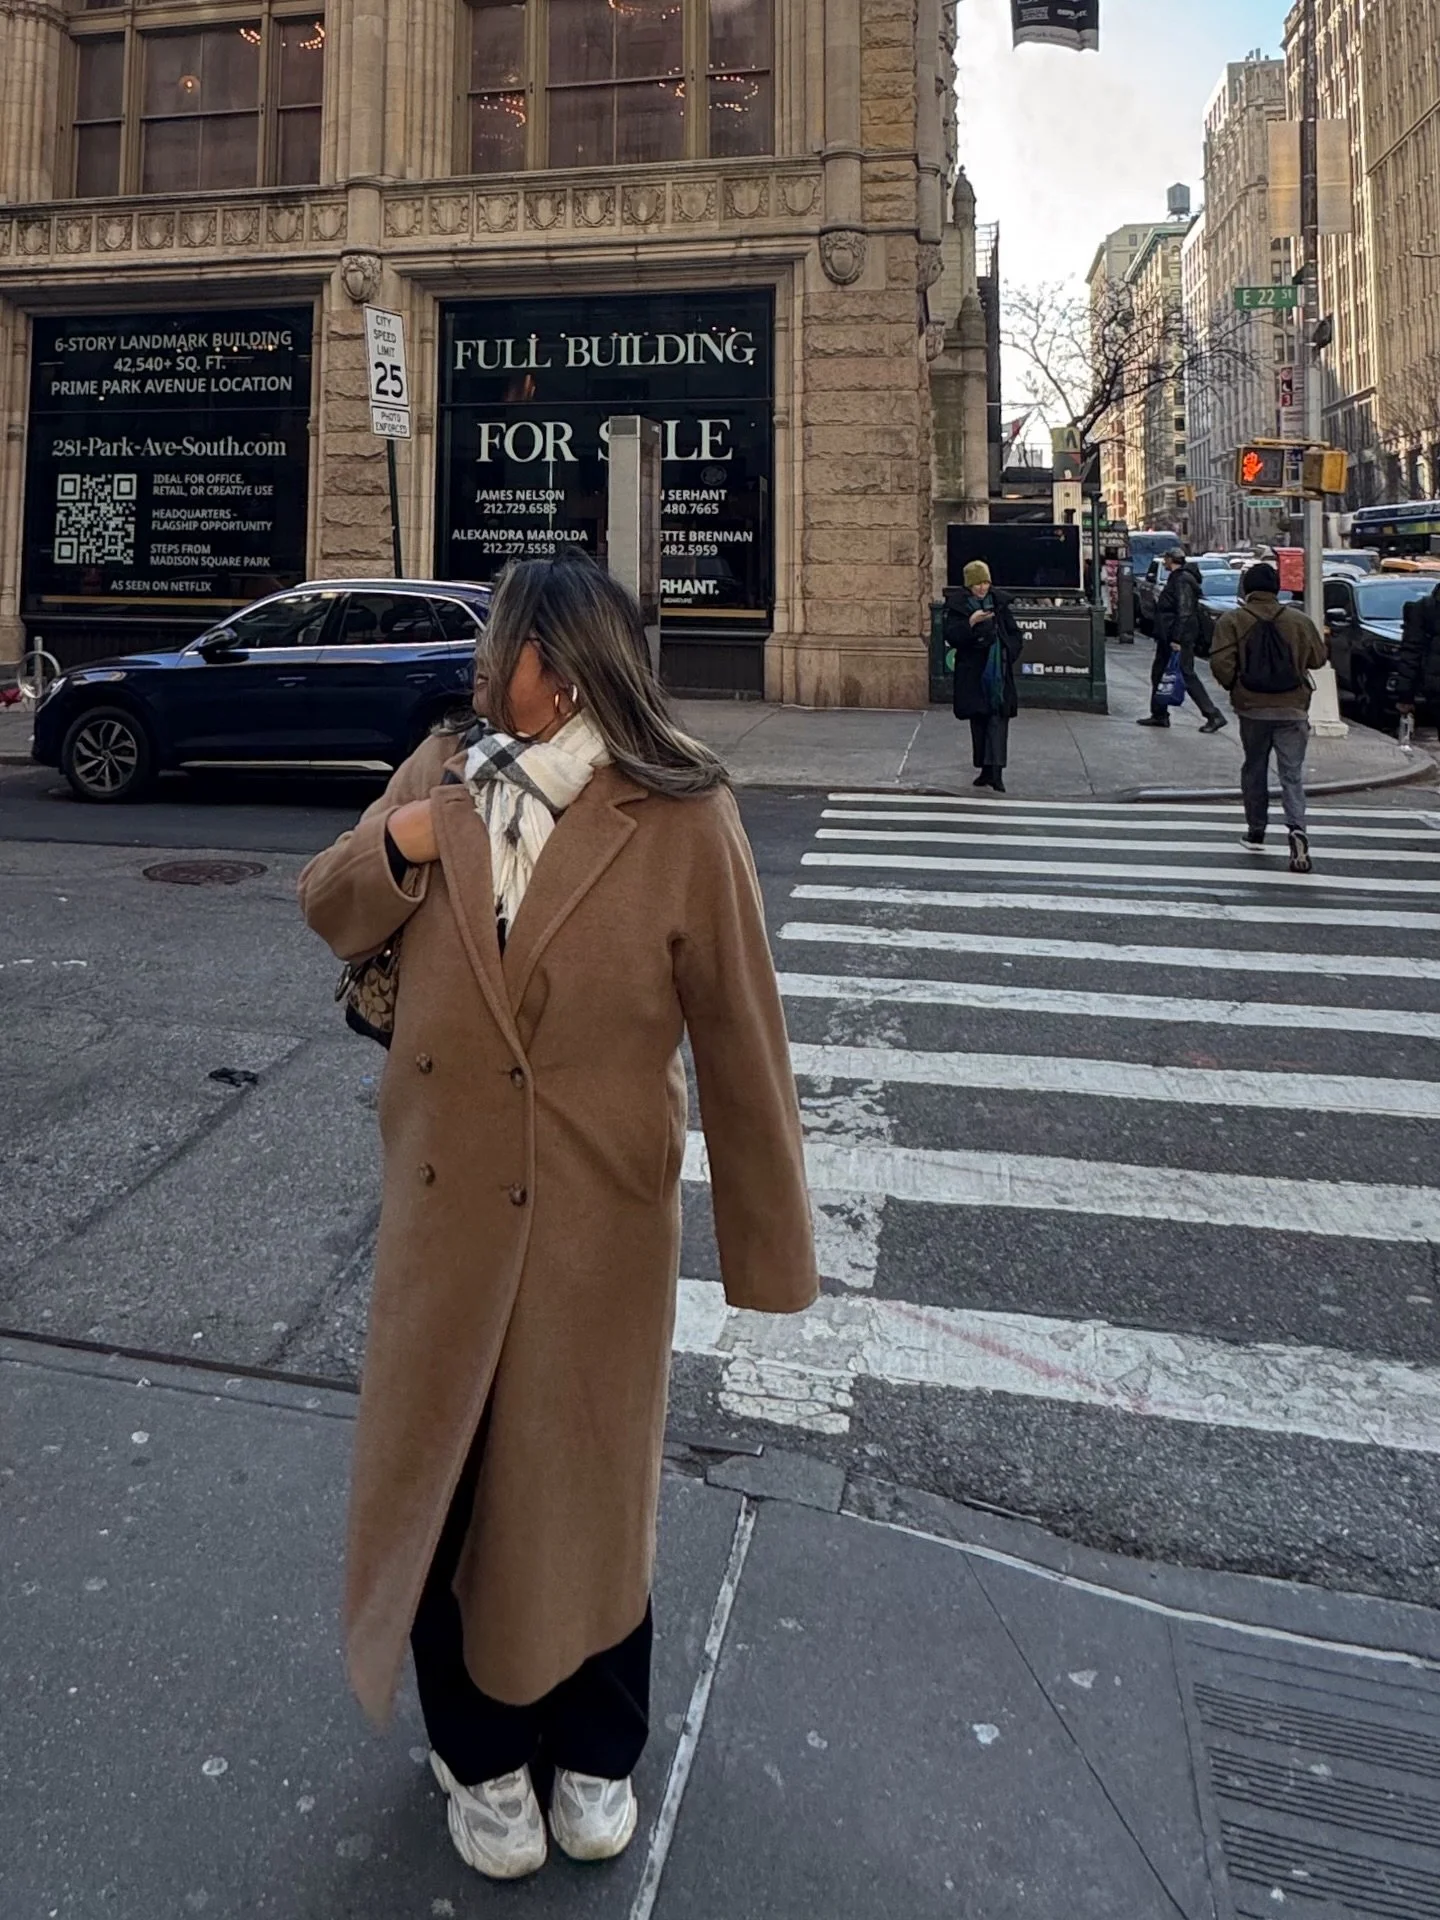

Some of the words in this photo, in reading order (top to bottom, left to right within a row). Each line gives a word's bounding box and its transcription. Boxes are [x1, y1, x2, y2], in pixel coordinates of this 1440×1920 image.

[1242, 289, 1251, 306] E
[1258, 288, 1275, 305] 22
[376, 315, 391, 326] CITY
[55, 336, 116, 351] 6-STORY
[120, 333, 208, 350] LANDMARK
[213, 331, 292, 347] BUILDING
[373, 329, 396, 343] SPEED
[377, 345, 395, 357] LIMIT
[453, 338, 551, 370] FULL
[565, 331, 757, 367] BUILDING
[113, 357, 171, 373] 42,540+
[175, 356, 201, 372] SQ.
[205, 355, 226, 370] FT.
[374, 361, 403, 398] 25
[51, 381, 98, 396] PRIME
[101, 379, 141, 394] PARK
[144, 378, 206, 394] AVENUE
[210, 376, 293, 392] LOCATION
[381, 411, 401, 422] PHOTO
[376, 422, 407, 434] ENFORCED
[52, 436, 287, 457] 281-Park-Ave-South.com
[476, 420, 578, 462] FOR
[153, 474, 182, 484] IDEAL
[185, 474, 205, 484] FOR
[206, 474, 244, 485] OFFICE,
[152, 486, 188, 497] RETAIL,
[190, 486, 205, 495] OR
[206, 486, 252, 495] CREATIVE
[254, 485, 273, 495] USE
[475, 489, 513, 502] JAMES
[516, 489, 565, 501] NELSON
[668, 489, 727, 501] SERHANT
[152, 509, 232, 520] HEADQUARTERS
[483, 503, 557, 514] 212.729.6585
[152, 521, 199, 531] FLAGSHIP
[200, 521, 272, 531] OPPORTUNITY
[452, 529, 524, 540] ALEXANDRA
[527, 530, 588, 541] MAROLDA
[689, 531, 753, 542] BRENNAN
[150, 544, 180, 554] STEPS
[181, 544, 211, 554] FROM
[150, 556, 199, 566] MADISON
[201, 556, 241, 568] SQUARE
[244, 556, 271, 567] PARK
[111, 580, 123, 590] AS
[125, 580, 150, 591] SEEN
[152, 580, 167, 591] ON
[170, 581, 212, 592] NETFLIX
[660, 579, 720, 596] RHANT.
